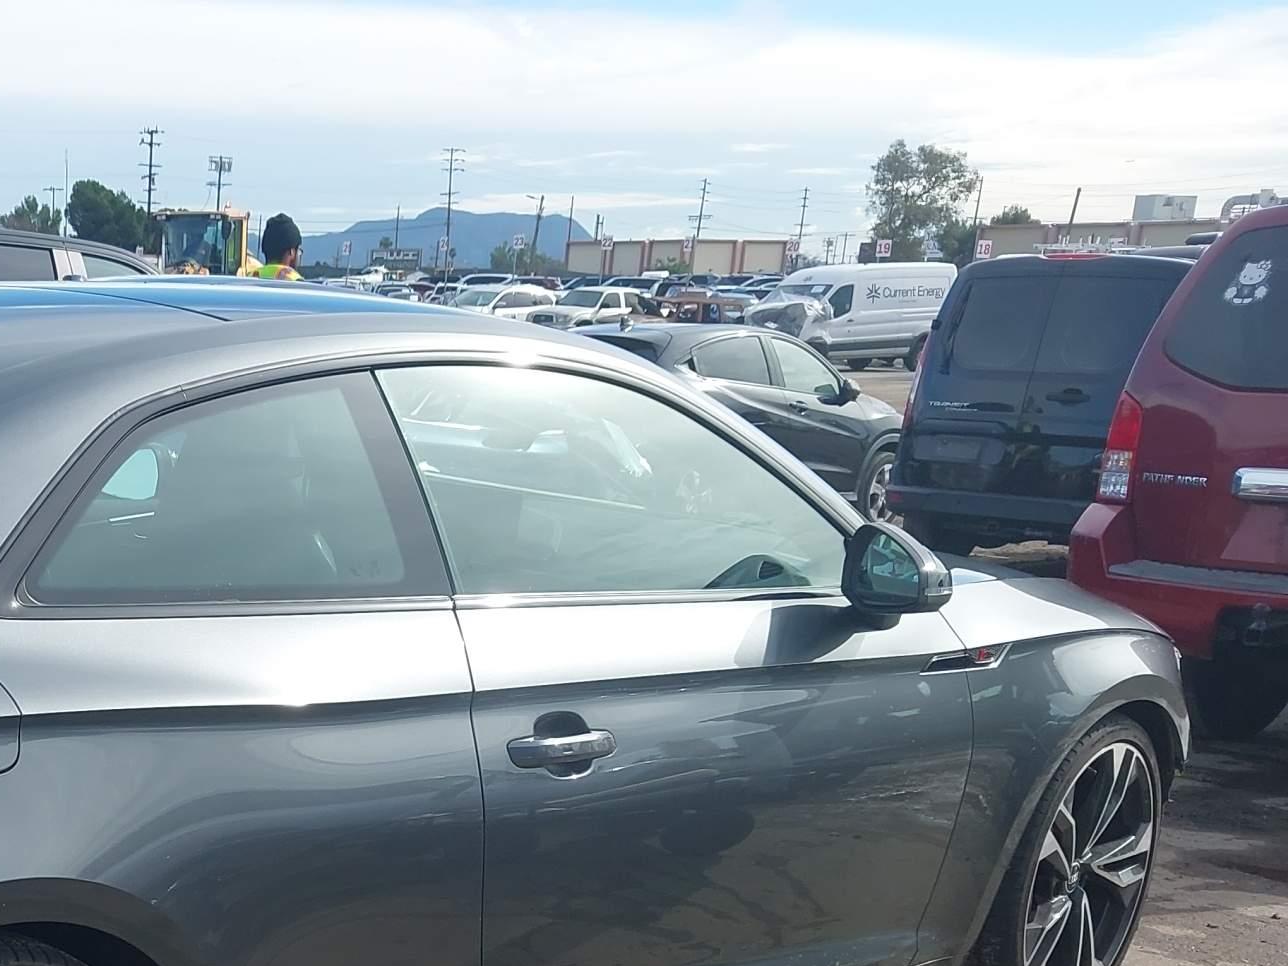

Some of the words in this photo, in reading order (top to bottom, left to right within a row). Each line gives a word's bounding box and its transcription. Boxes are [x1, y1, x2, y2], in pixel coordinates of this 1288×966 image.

[514, 237, 524, 246] 23
[602, 238, 612, 248] 22
[786, 241, 800, 252] 20
[877, 243, 890, 254] 19
[977, 244, 990, 255] 18
[882, 286, 916, 299] Current
[917, 285, 946, 299] Energy
[1142, 472, 1208, 488] PATHFNDER
